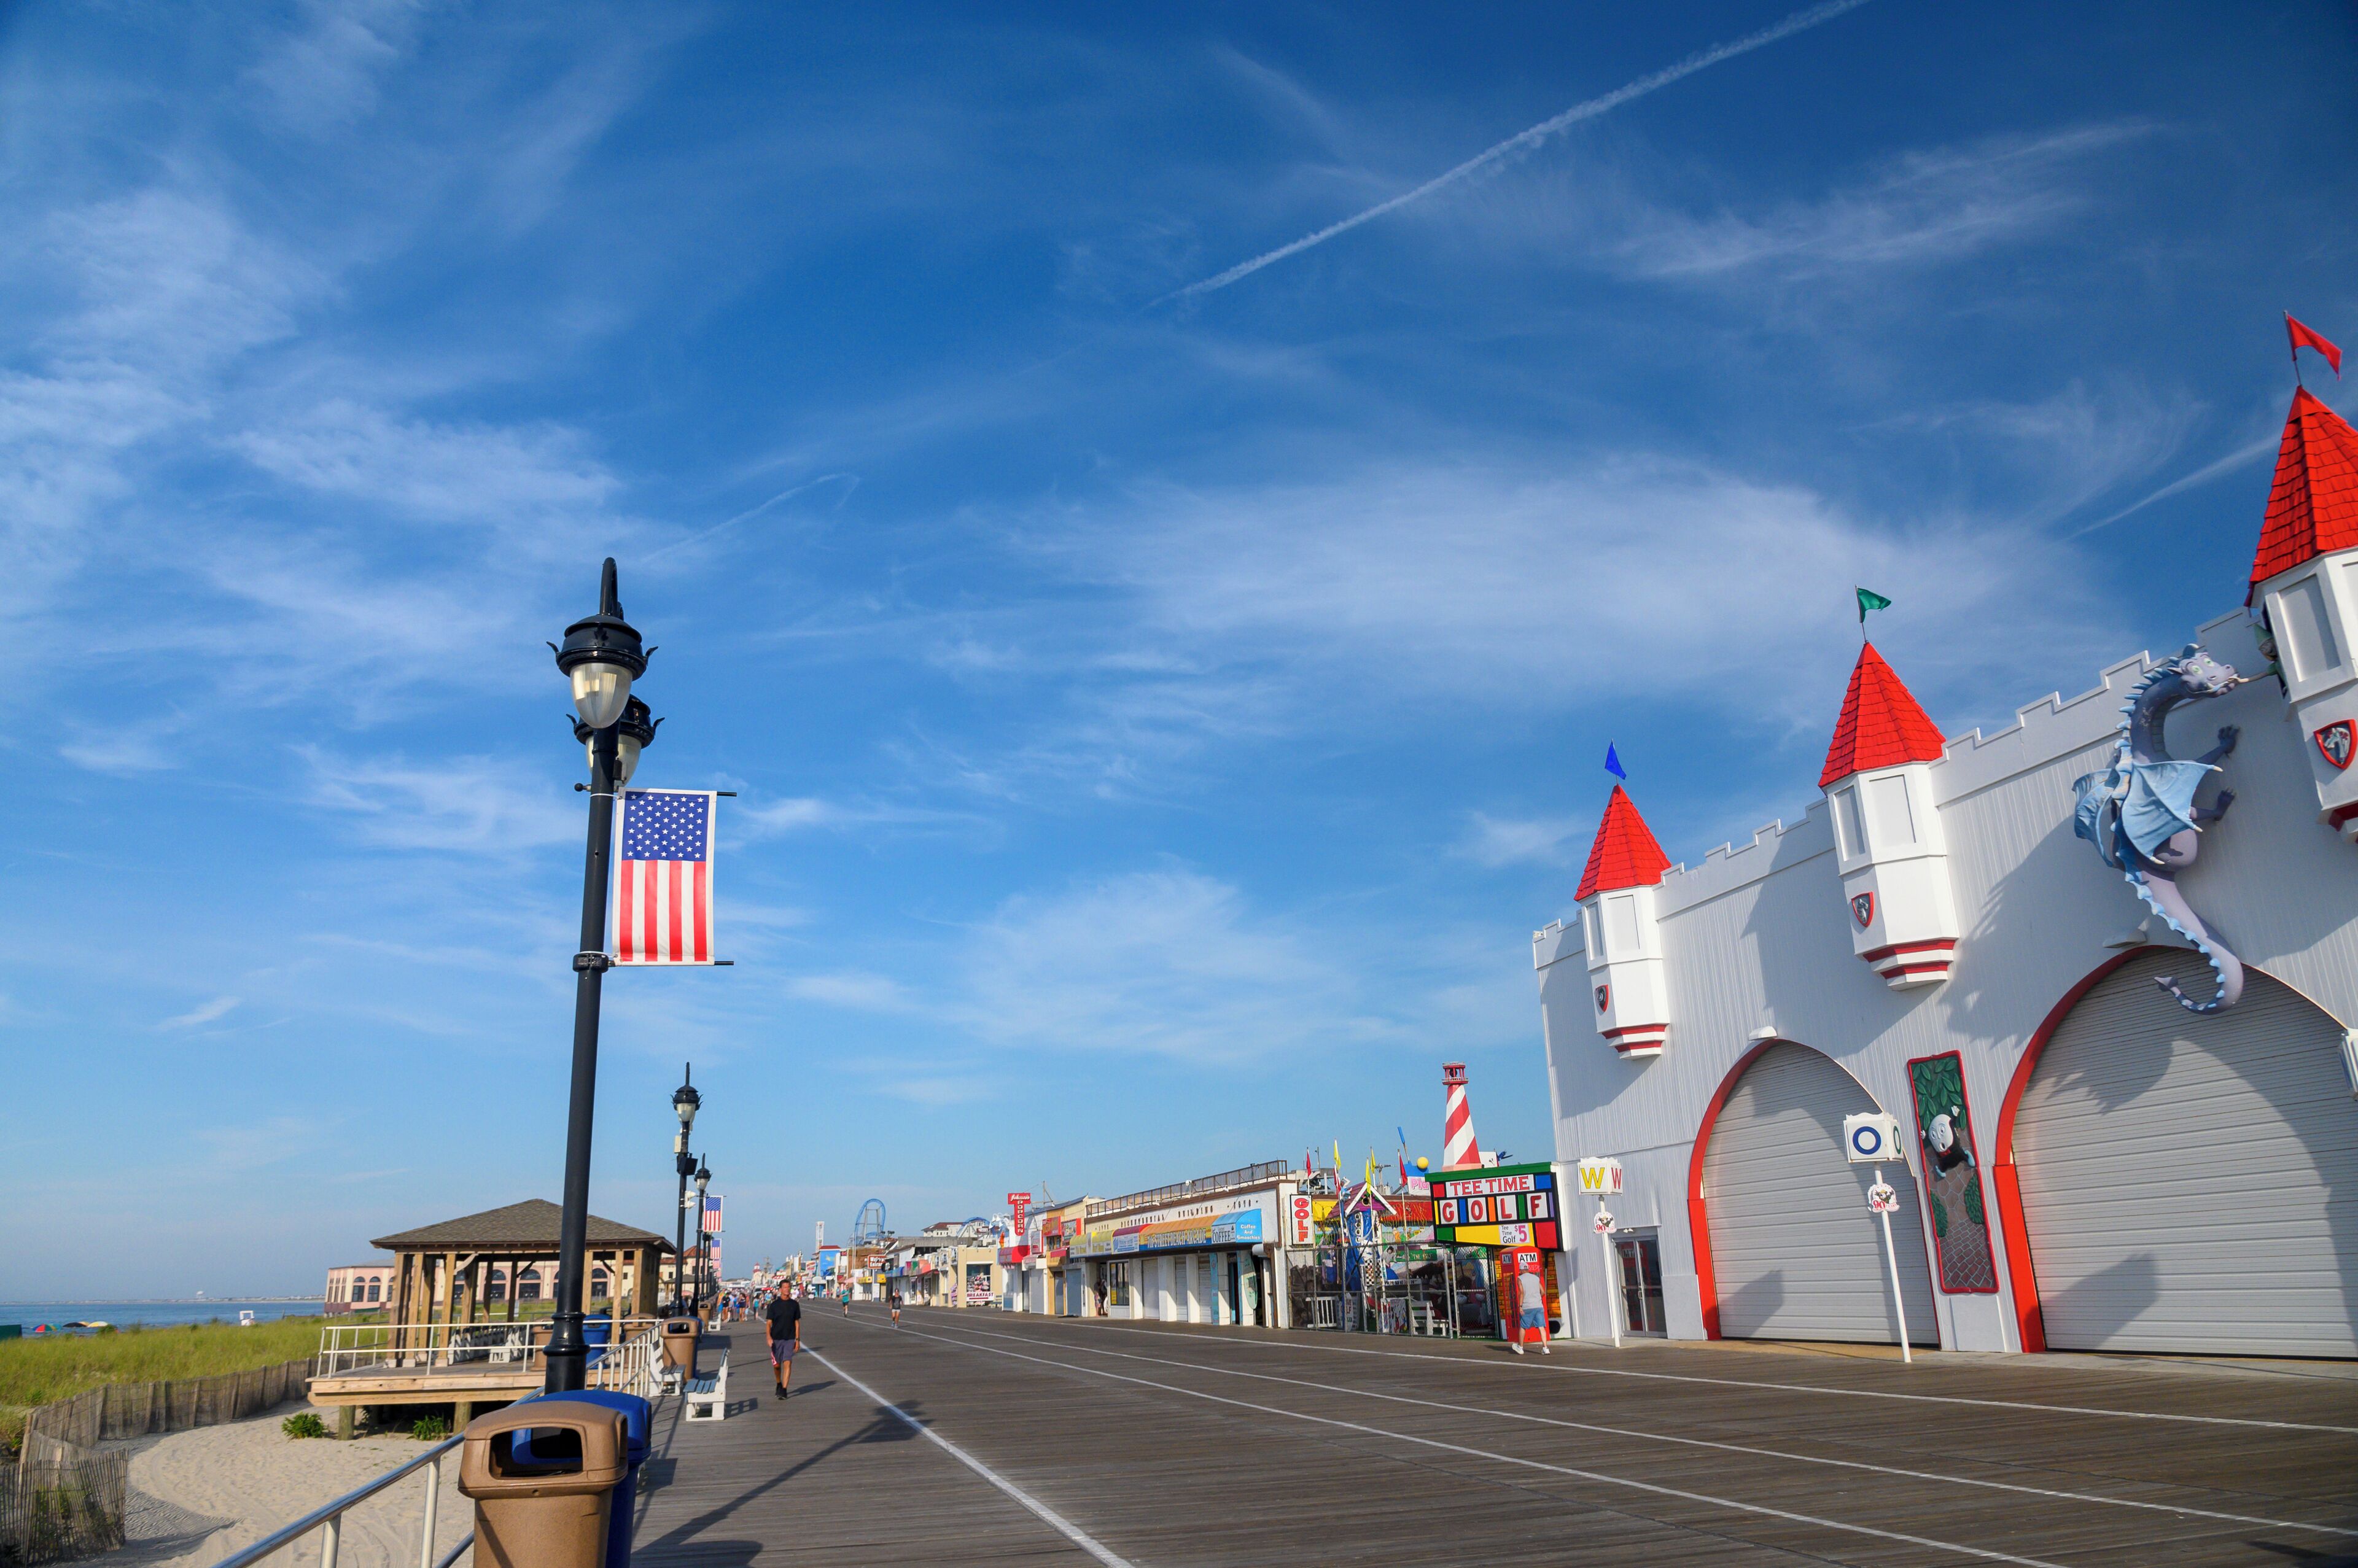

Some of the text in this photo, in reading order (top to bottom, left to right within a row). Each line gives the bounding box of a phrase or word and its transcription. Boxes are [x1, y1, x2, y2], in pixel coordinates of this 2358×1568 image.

[1450, 1176, 1530, 1196] TEE TIME
[1581, 1167, 1605, 1189] W
[1611, 1167, 1622, 1189] W
[1442, 1195, 1542, 1222] GOLF
[1294, 1198, 1309, 1242] GOLF
[1154, 1233, 1170, 1248] STREET
[1170, 1231, 1186, 1246] BEACH
[1186, 1228, 1207, 1244] ARCADE
[1212, 1230, 1231, 1243] COFFEE
[1503, 1235, 1516, 1244] Golf
[1514, 1225, 1528, 1243] $5
[1503, 1254, 1512, 1263] ATM
[1519, 1254, 1536, 1262] ATM
